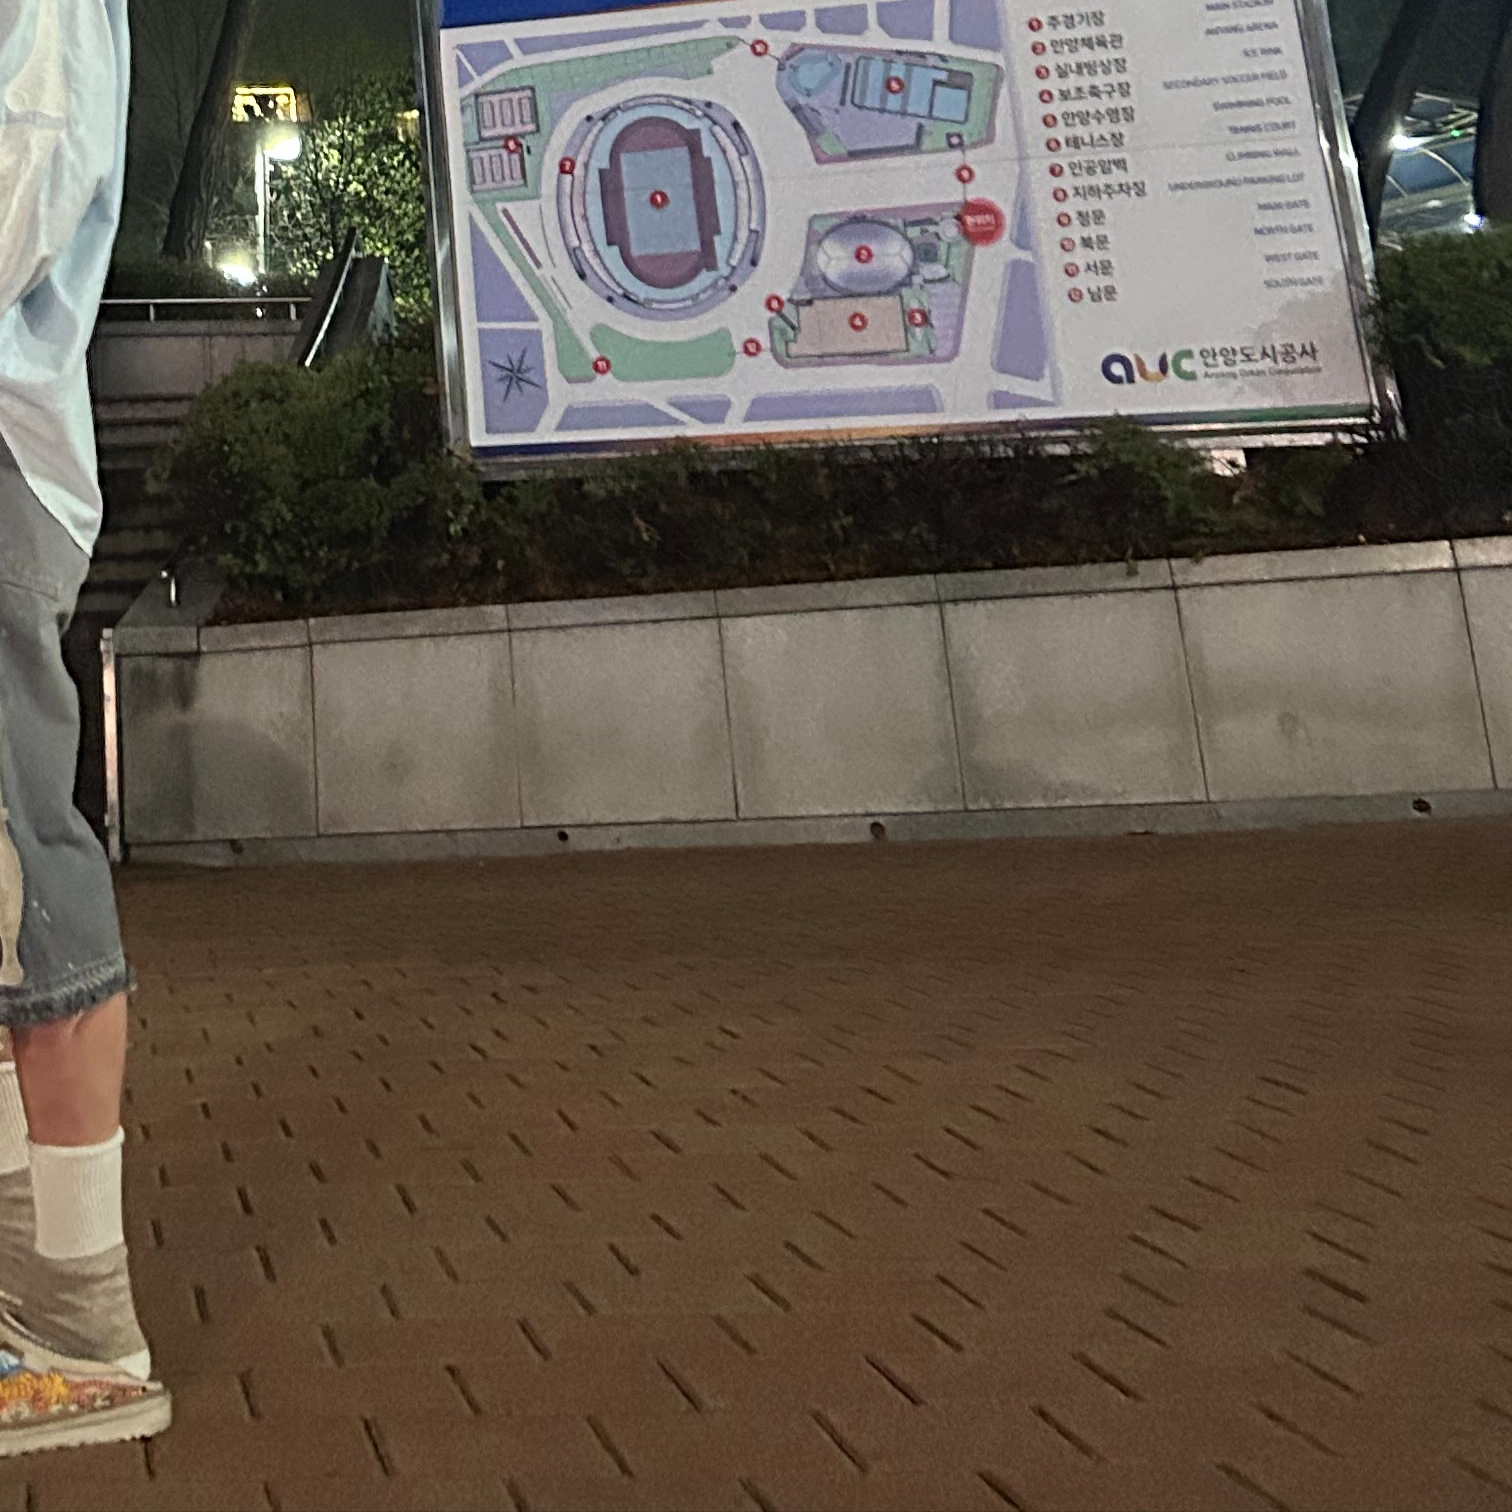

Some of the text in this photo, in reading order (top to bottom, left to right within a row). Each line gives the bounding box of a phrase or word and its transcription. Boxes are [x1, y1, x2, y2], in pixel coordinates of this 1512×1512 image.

[1047, 10, 1105, 30] 주경기장
[1050, 33, 1123, 54] 안양체육관
[1055, 57, 1127, 79] 실내빙상장
[1058, 81, 1131, 101] 보조축구장
[1061, 106, 1136, 127] 안양수영장
[1065, 131, 1125, 150] 테니스장
[1068, 157, 1128, 177] 인공암벽
[1072, 180, 1147, 201] 지하주차장
[1076, 209, 1106, 227] 정문
[1084, 259, 1114, 277] 서문
[1088, 284, 1119, 303] 남문
[1199, 341, 1318, 368] 안양도시공사
